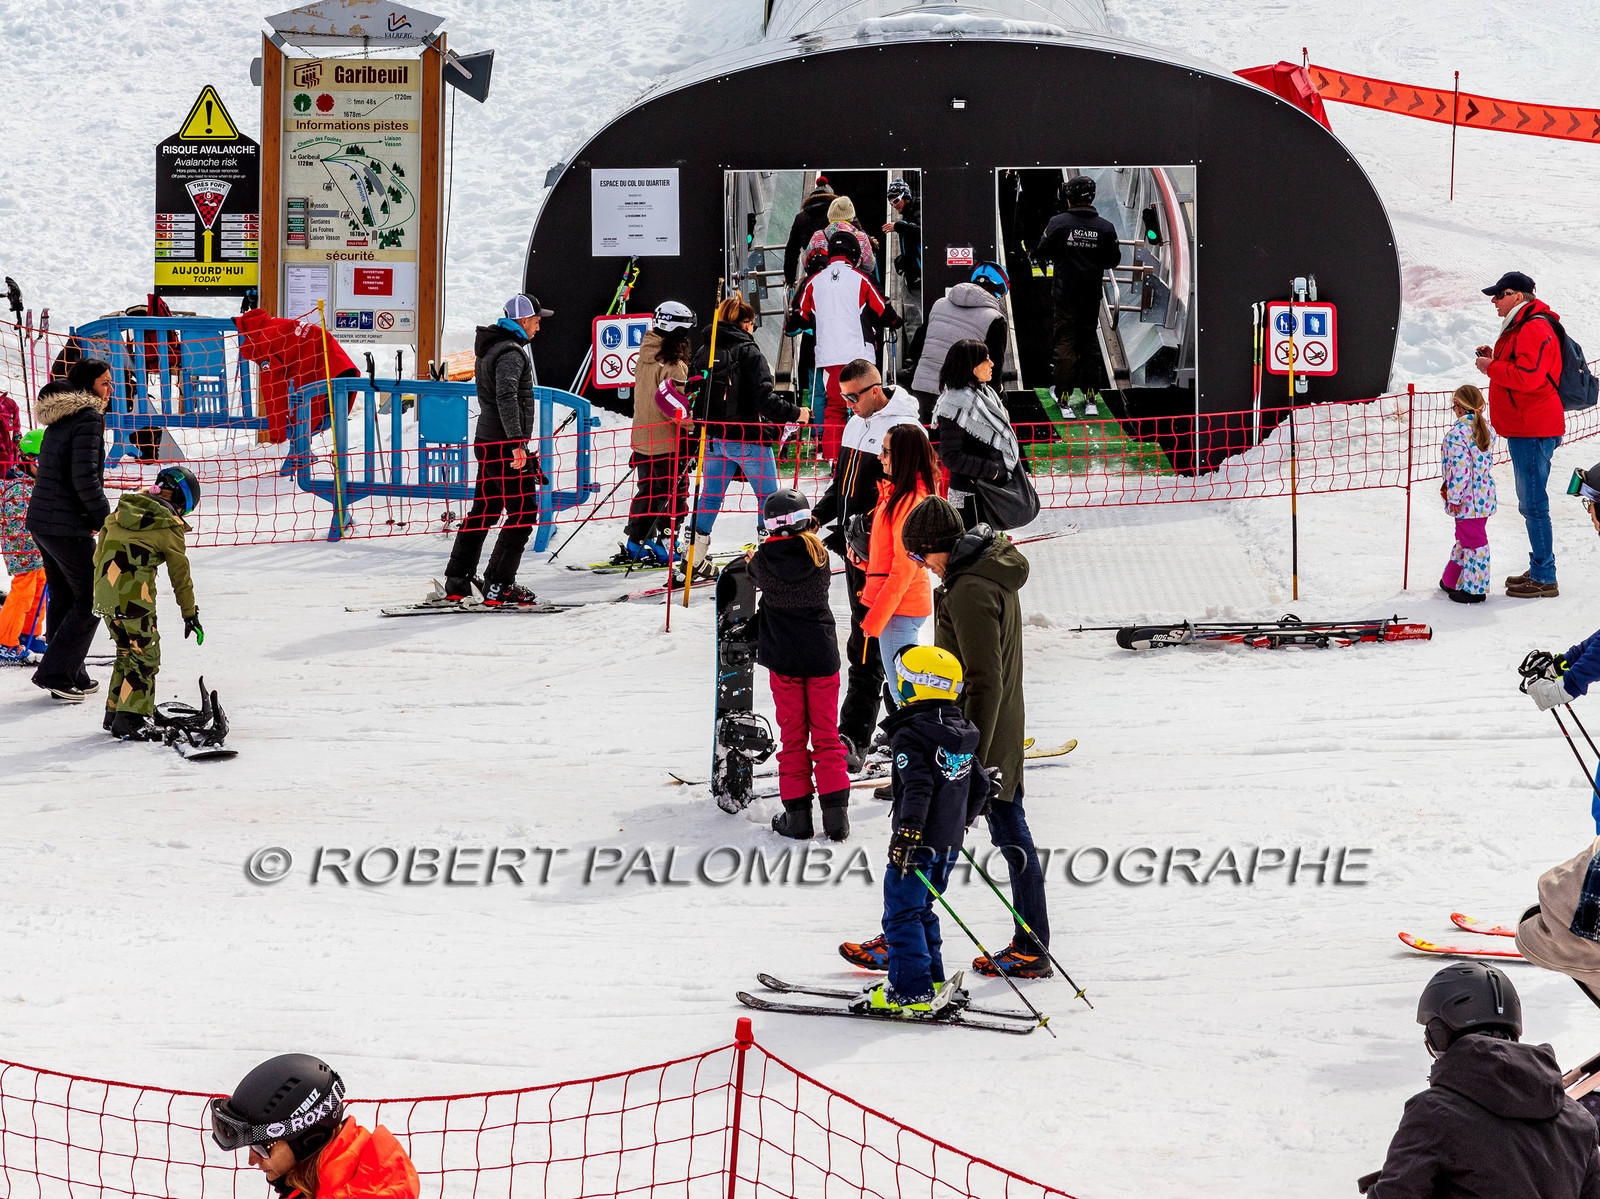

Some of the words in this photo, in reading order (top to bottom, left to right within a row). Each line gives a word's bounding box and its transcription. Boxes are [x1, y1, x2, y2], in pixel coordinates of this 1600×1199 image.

[334, 65, 409, 84] Garibeuil
[296, 120, 370, 130] Informations
[373, 121, 409, 132] pistes
[297, 138, 314, 148] Chemin
[324, 135, 342, 143] Fouines
[162, 145, 198, 154] RISQUE
[199, 145, 256, 154] AVALANCHE
[174, 158, 220, 166] Avalanche
[221, 158, 238, 166] risk
[646, 179, 670, 187] QUARTIER
[325, 251, 375, 261] sécurité
[172, 266, 244, 275] AUJOURD'HUI
[291, 1094, 333, 1131] ROXY
